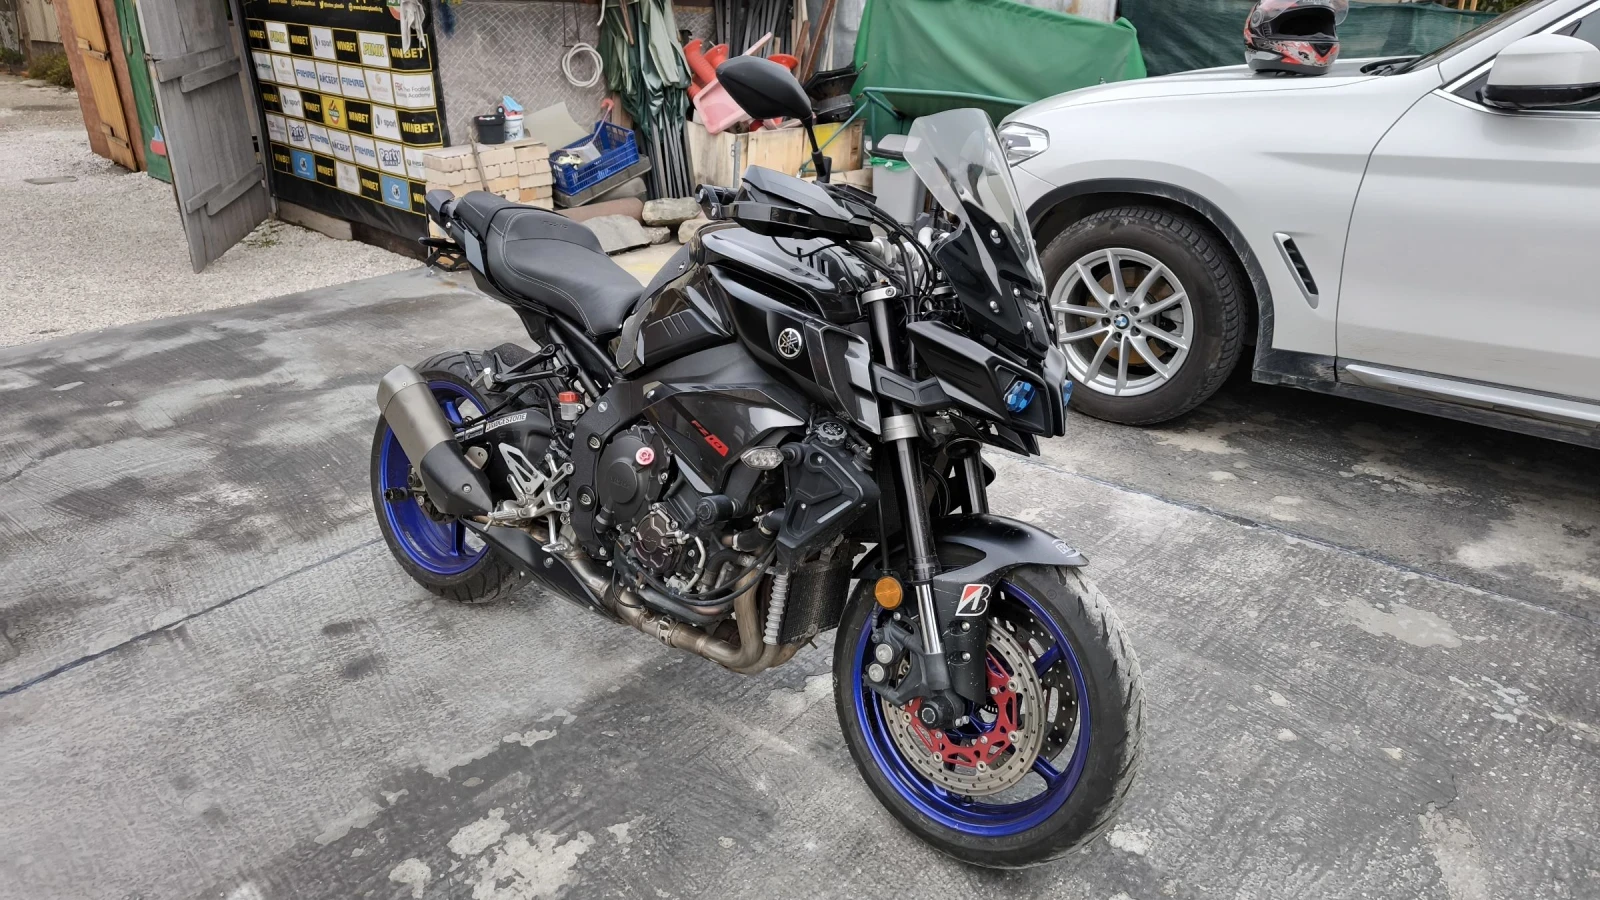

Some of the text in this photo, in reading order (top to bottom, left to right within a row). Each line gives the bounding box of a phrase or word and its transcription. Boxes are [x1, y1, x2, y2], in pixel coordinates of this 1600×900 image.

[290, 34, 309, 45] WINBET
[336, 40, 357, 52] WINBET
[390, 47, 424, 59] WINBET
[304, 101, 321, 113] WINBET
[348, 110, 369, 124] WINBET
[383, 119, 397, 128] sport
[402, 121, 434, 134] WINBET
[379, 147, 401, 165] Party
[316, 164, 334, 177] WINBET
[362, 177, 379, 191] WINBET
